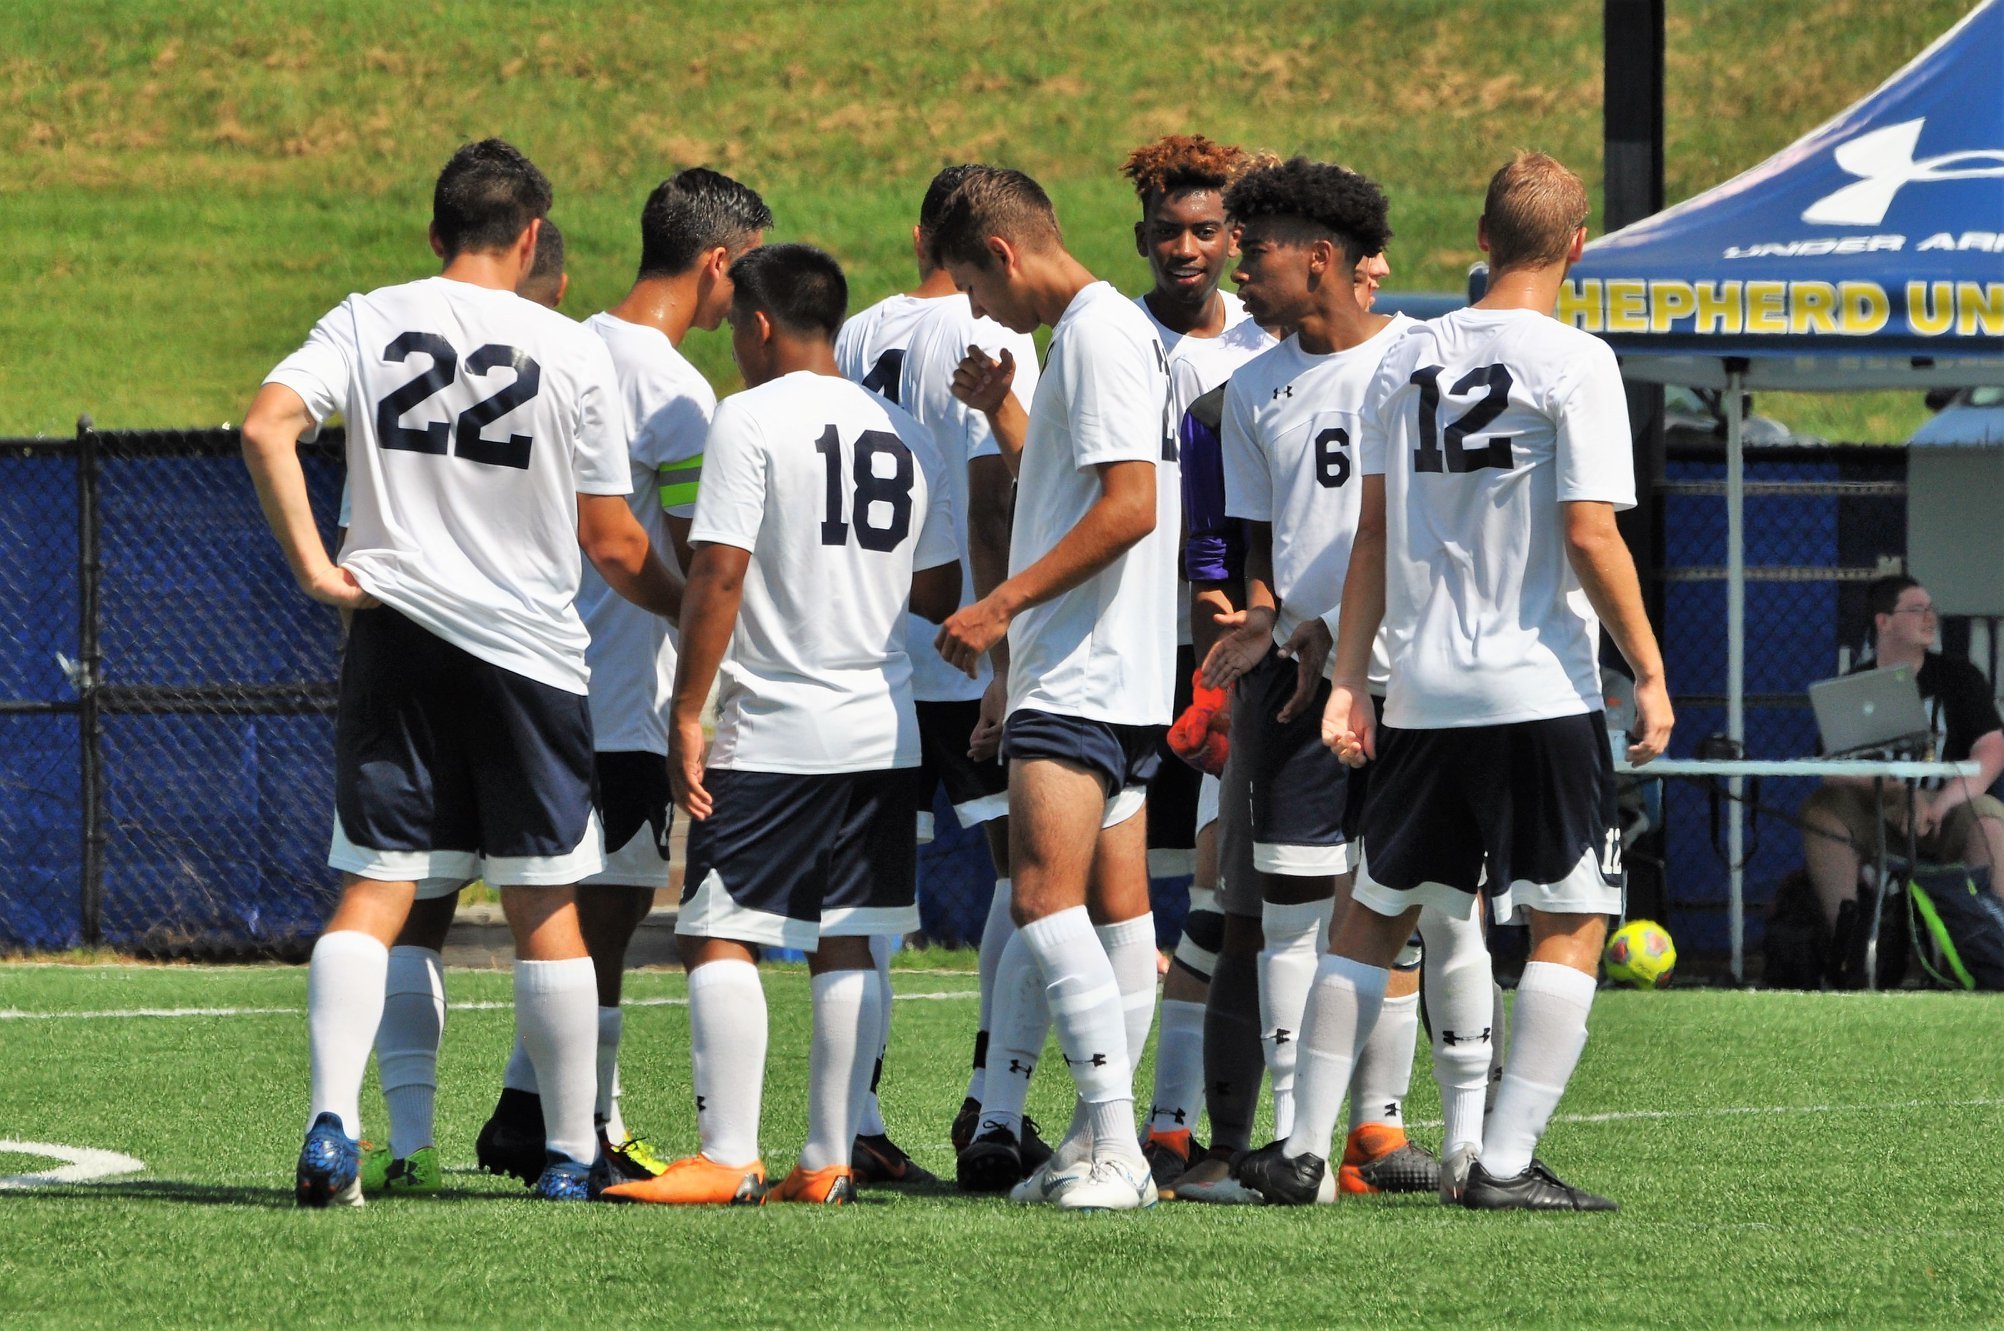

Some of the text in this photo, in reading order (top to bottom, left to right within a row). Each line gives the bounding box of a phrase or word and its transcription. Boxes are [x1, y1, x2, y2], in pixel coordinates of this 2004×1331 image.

[1722, 230, 2004, 259] UNDER AR
[1555, 277, 1891, 335] HEPHERD
[377, 331, 541, 470] 22
[1409, 363, 1515, 474] 12
[815, 423, 915, 553] 18
[1315, 427, 1351, 489] 6
[1601, 827, 1622, 875] 12
